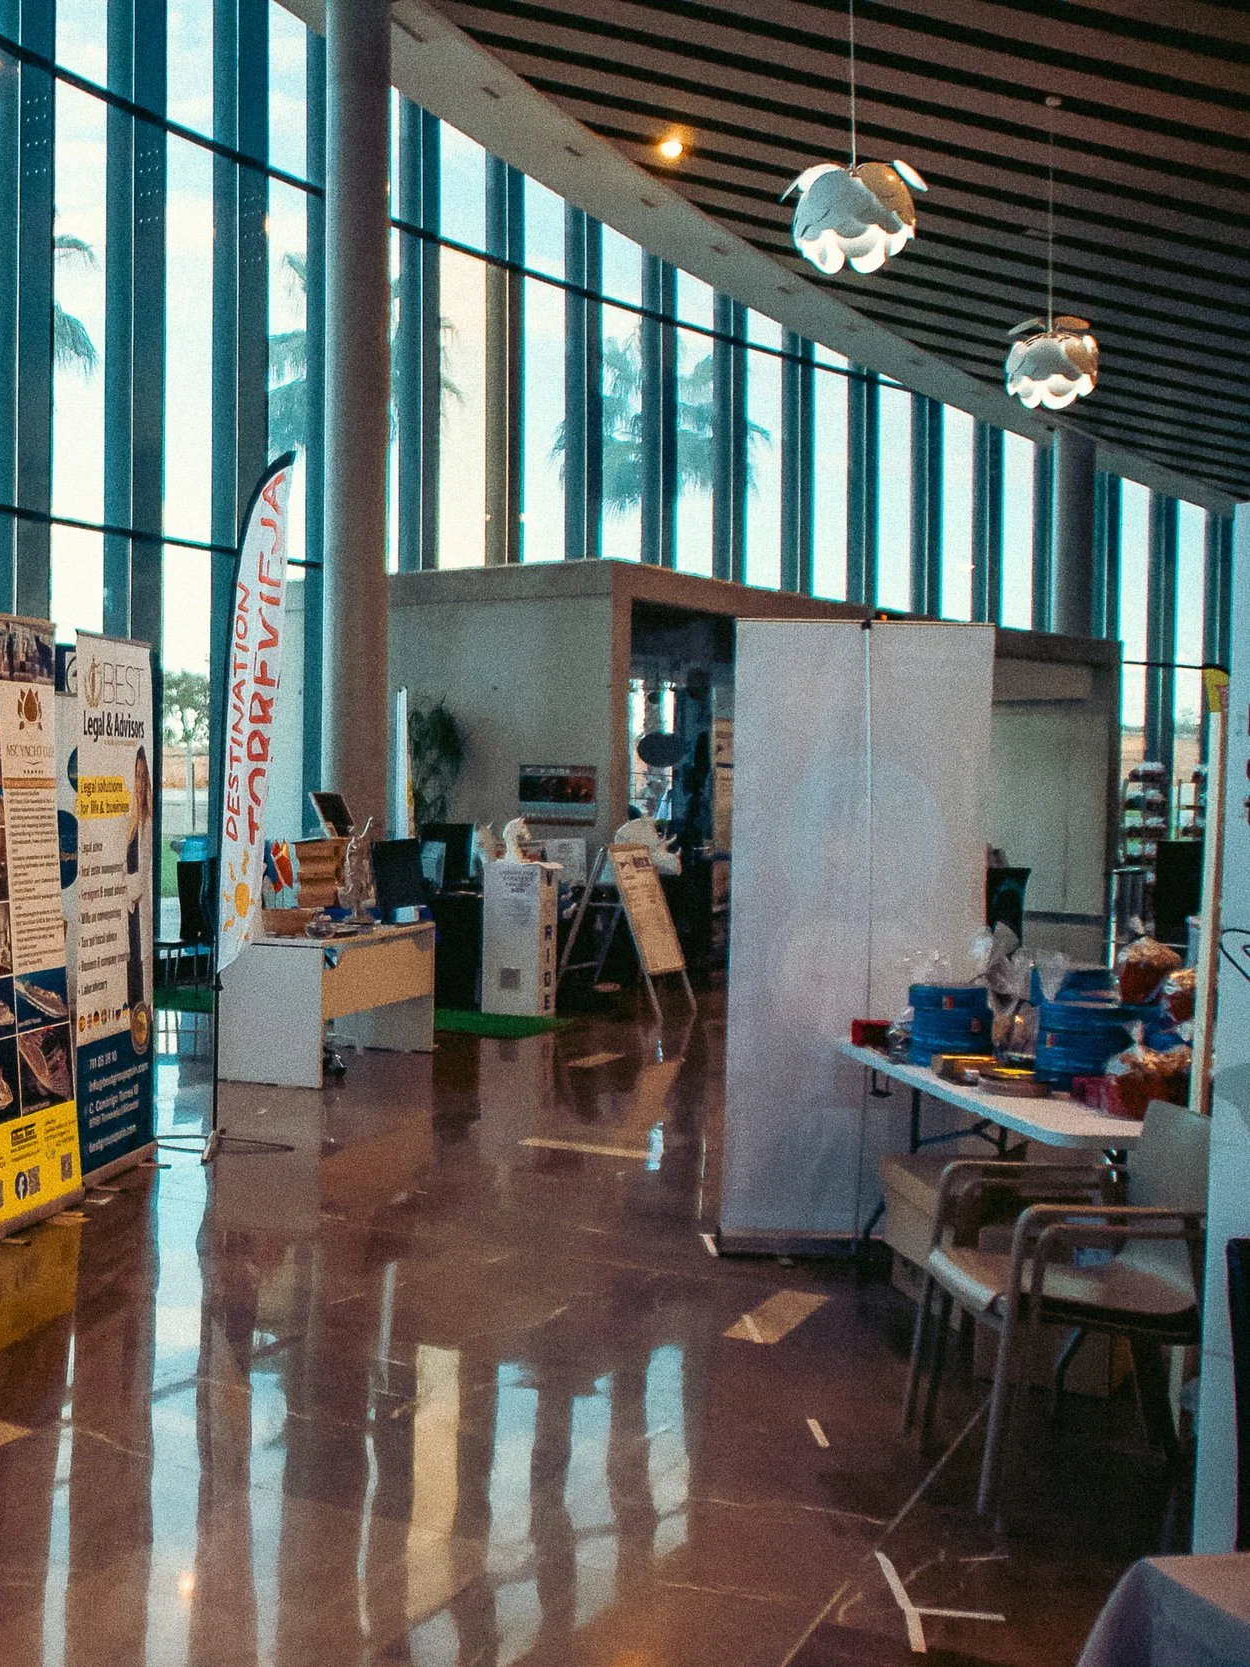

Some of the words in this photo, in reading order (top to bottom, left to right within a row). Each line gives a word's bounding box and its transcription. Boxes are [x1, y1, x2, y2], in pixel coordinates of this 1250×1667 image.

[102, 662, 144, 707] BEST
[83, 710, 105, 742] Legal
[106, 711, 113, 737] &
[114, 712, 145, 739] Advisors
[225, 581, 250, 842] DESTINATION
[80, 778, 97, 797] Legal
